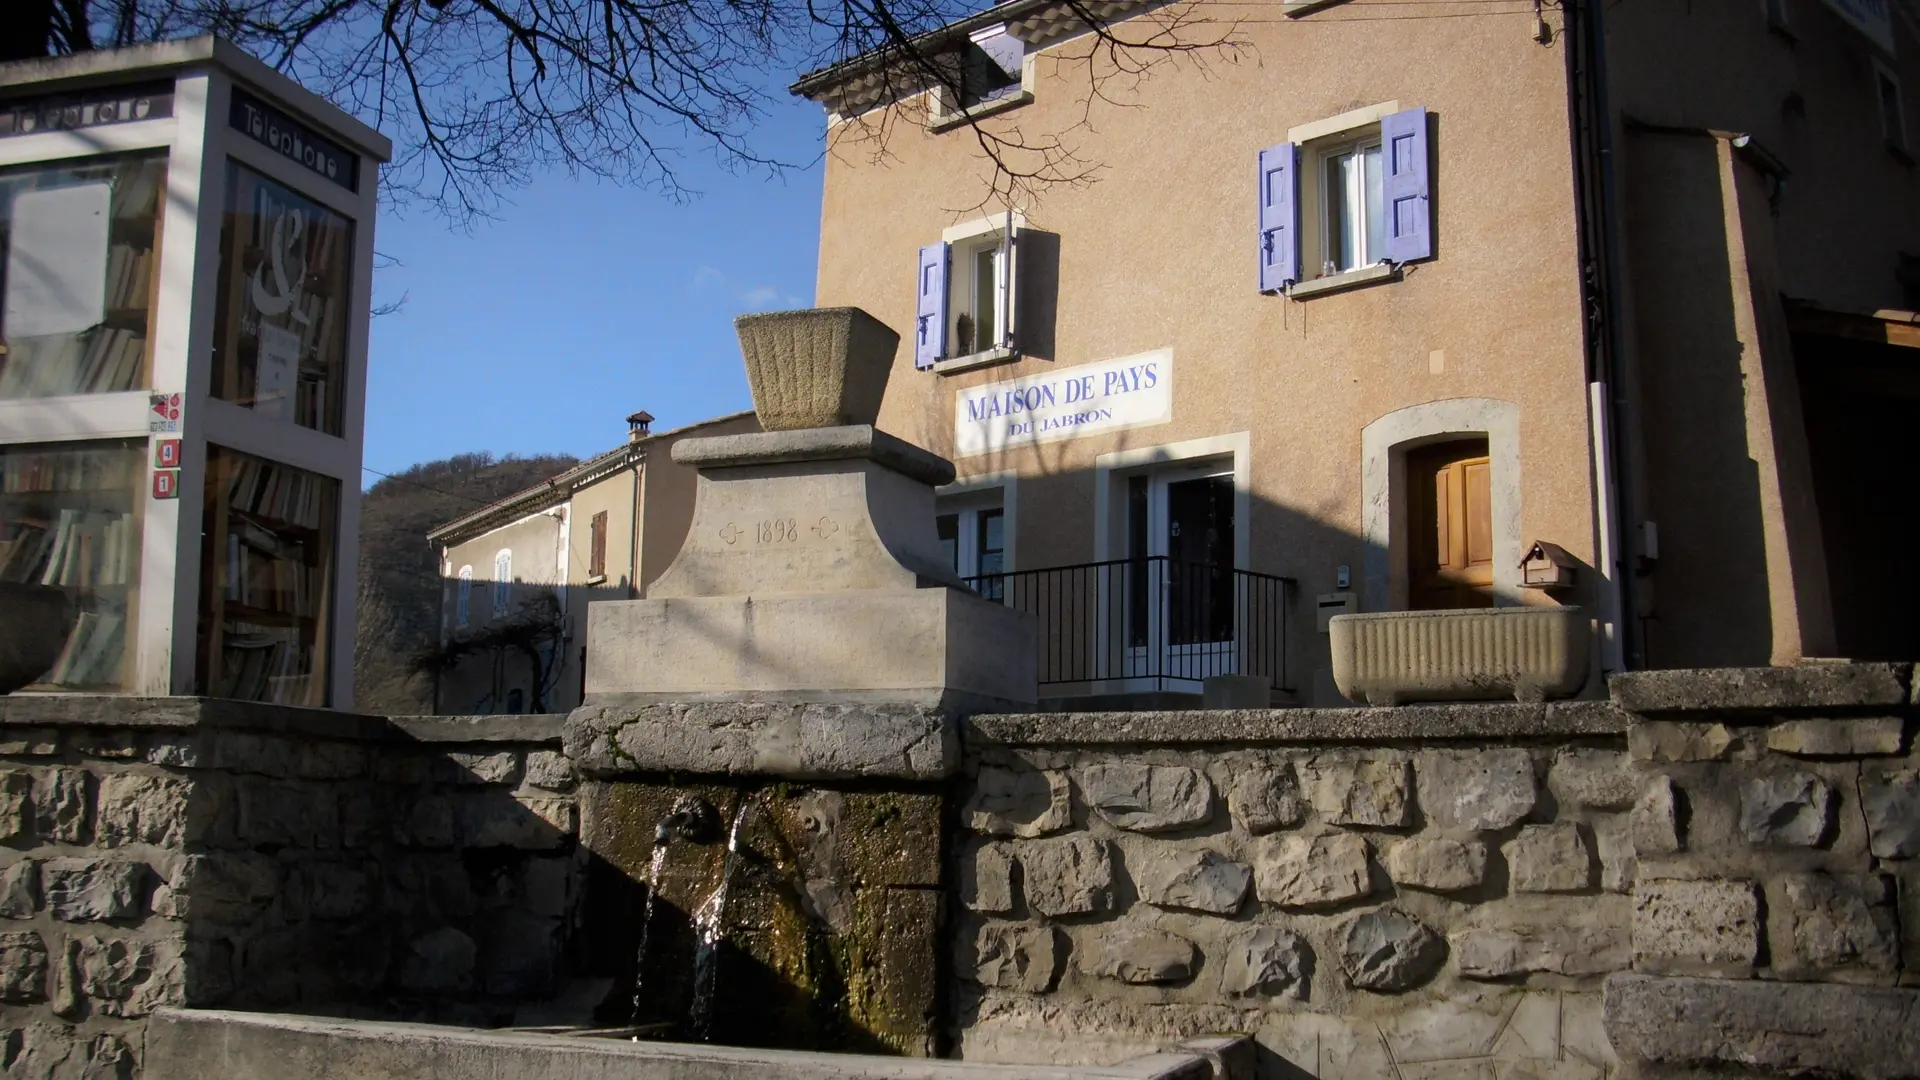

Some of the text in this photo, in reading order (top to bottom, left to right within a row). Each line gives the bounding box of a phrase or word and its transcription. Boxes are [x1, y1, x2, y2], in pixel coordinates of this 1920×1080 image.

[967, 362, 1157, 422] MAISON DE PAYS
[1009, 408, 1113, 436] DU JABRON
[756, 518, 799, 544] 1898
